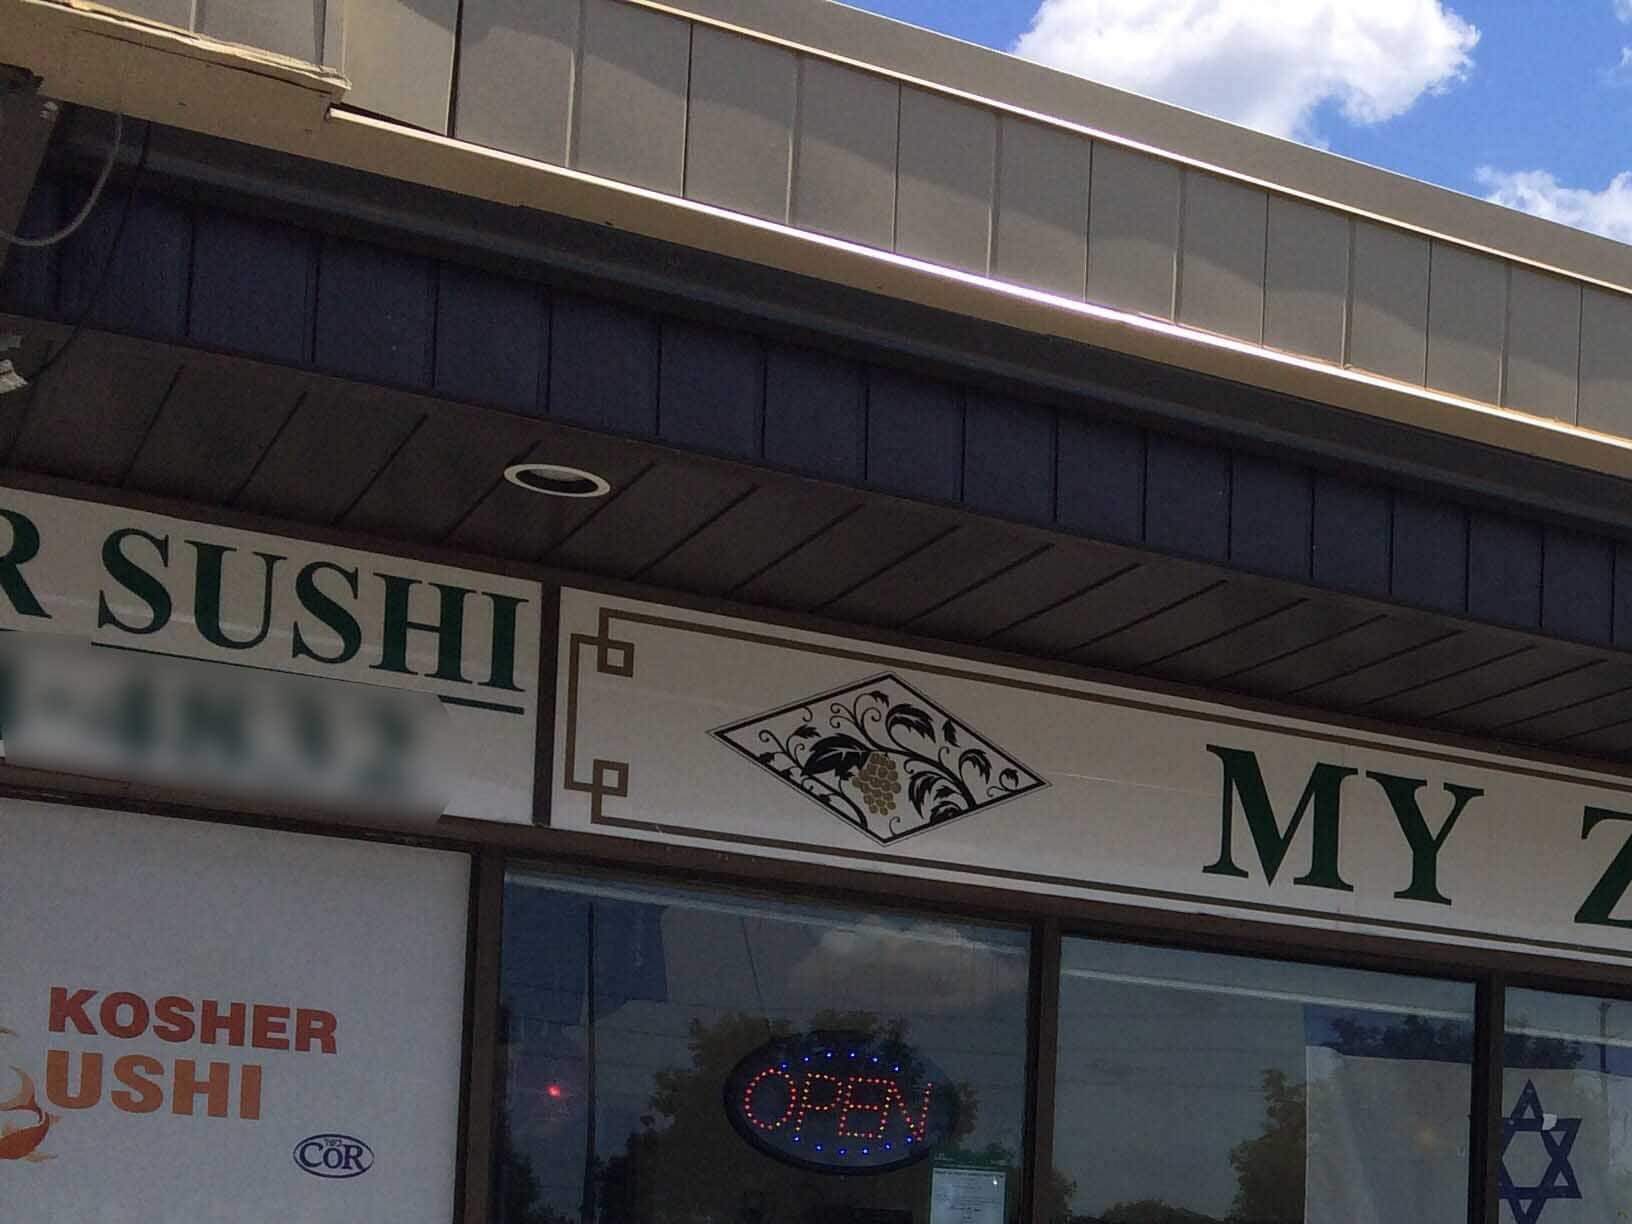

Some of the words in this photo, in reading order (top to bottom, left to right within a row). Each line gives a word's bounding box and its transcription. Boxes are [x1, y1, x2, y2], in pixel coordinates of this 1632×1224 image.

[98, 527, 528, 692] SUSHI
[1202, 743, 1484, 906] MY
[48, 986, 338, 1054] KOSHER
[745, 1068, 932, 1142] OPEN
